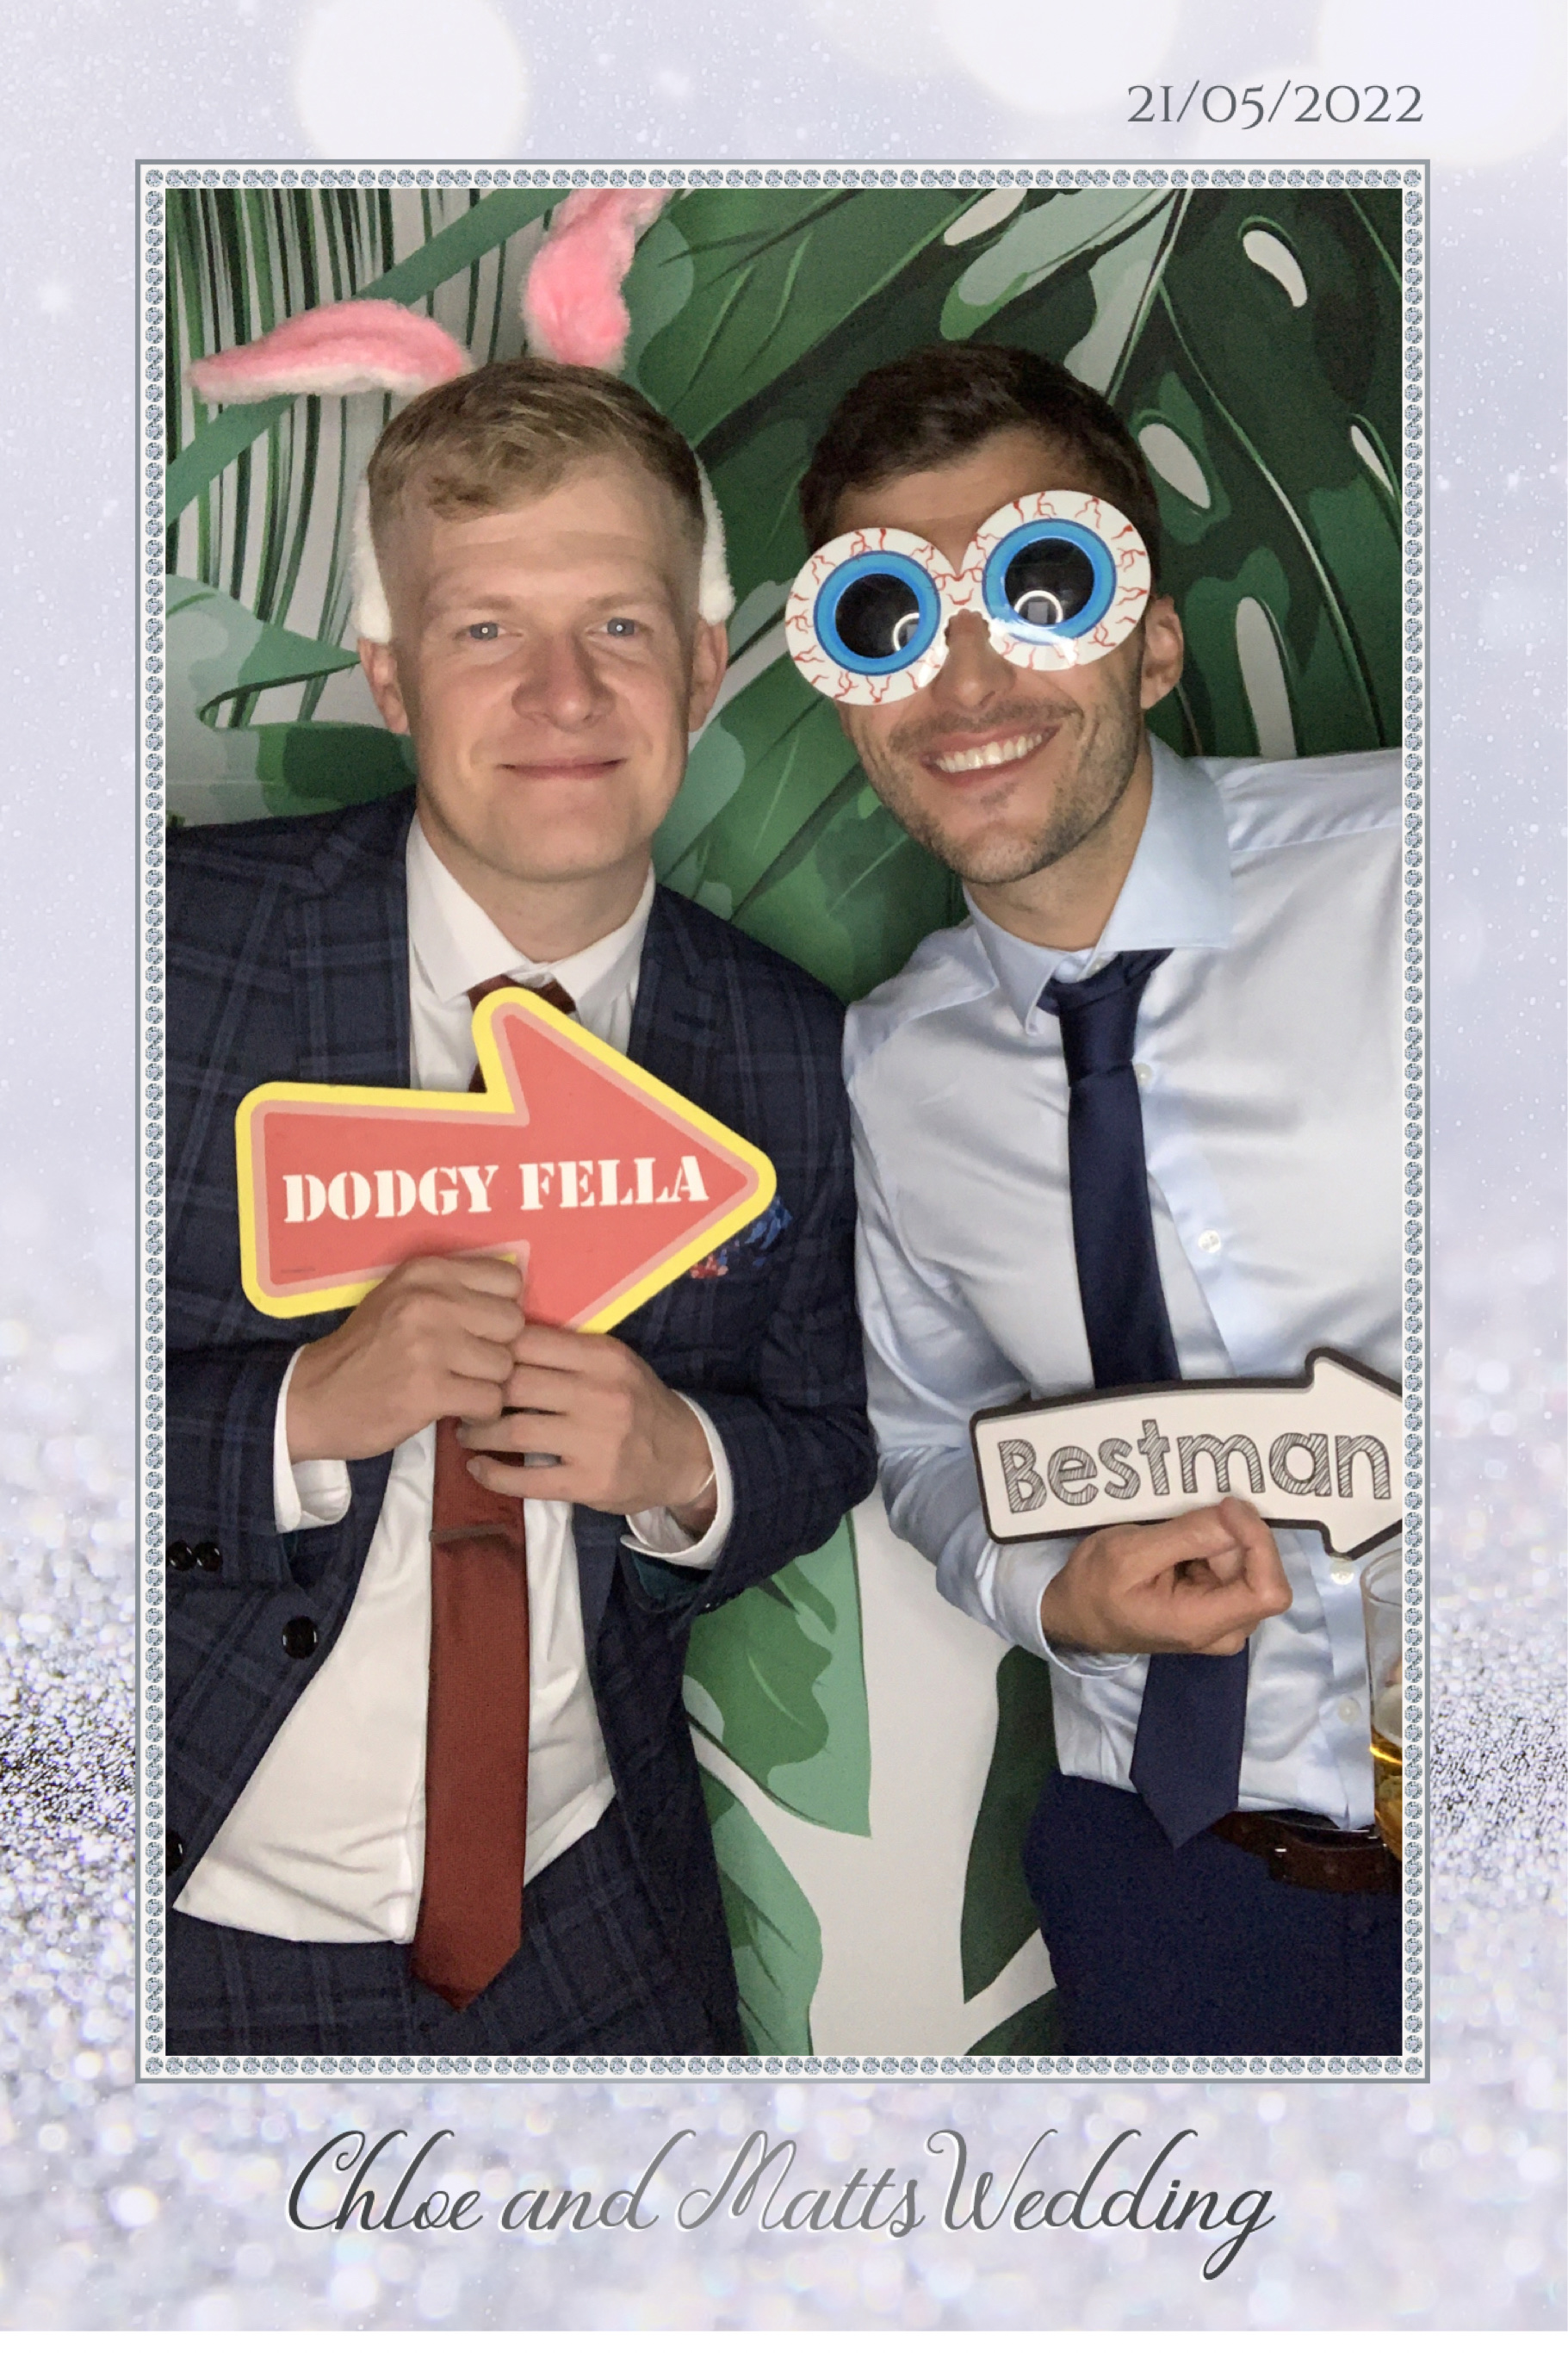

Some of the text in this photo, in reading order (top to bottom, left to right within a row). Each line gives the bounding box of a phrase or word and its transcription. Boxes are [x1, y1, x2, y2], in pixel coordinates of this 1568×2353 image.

[283, 1155, 710, 1223] DODGY FELLA
[997, 1419, 1391, 1514] Bestman
